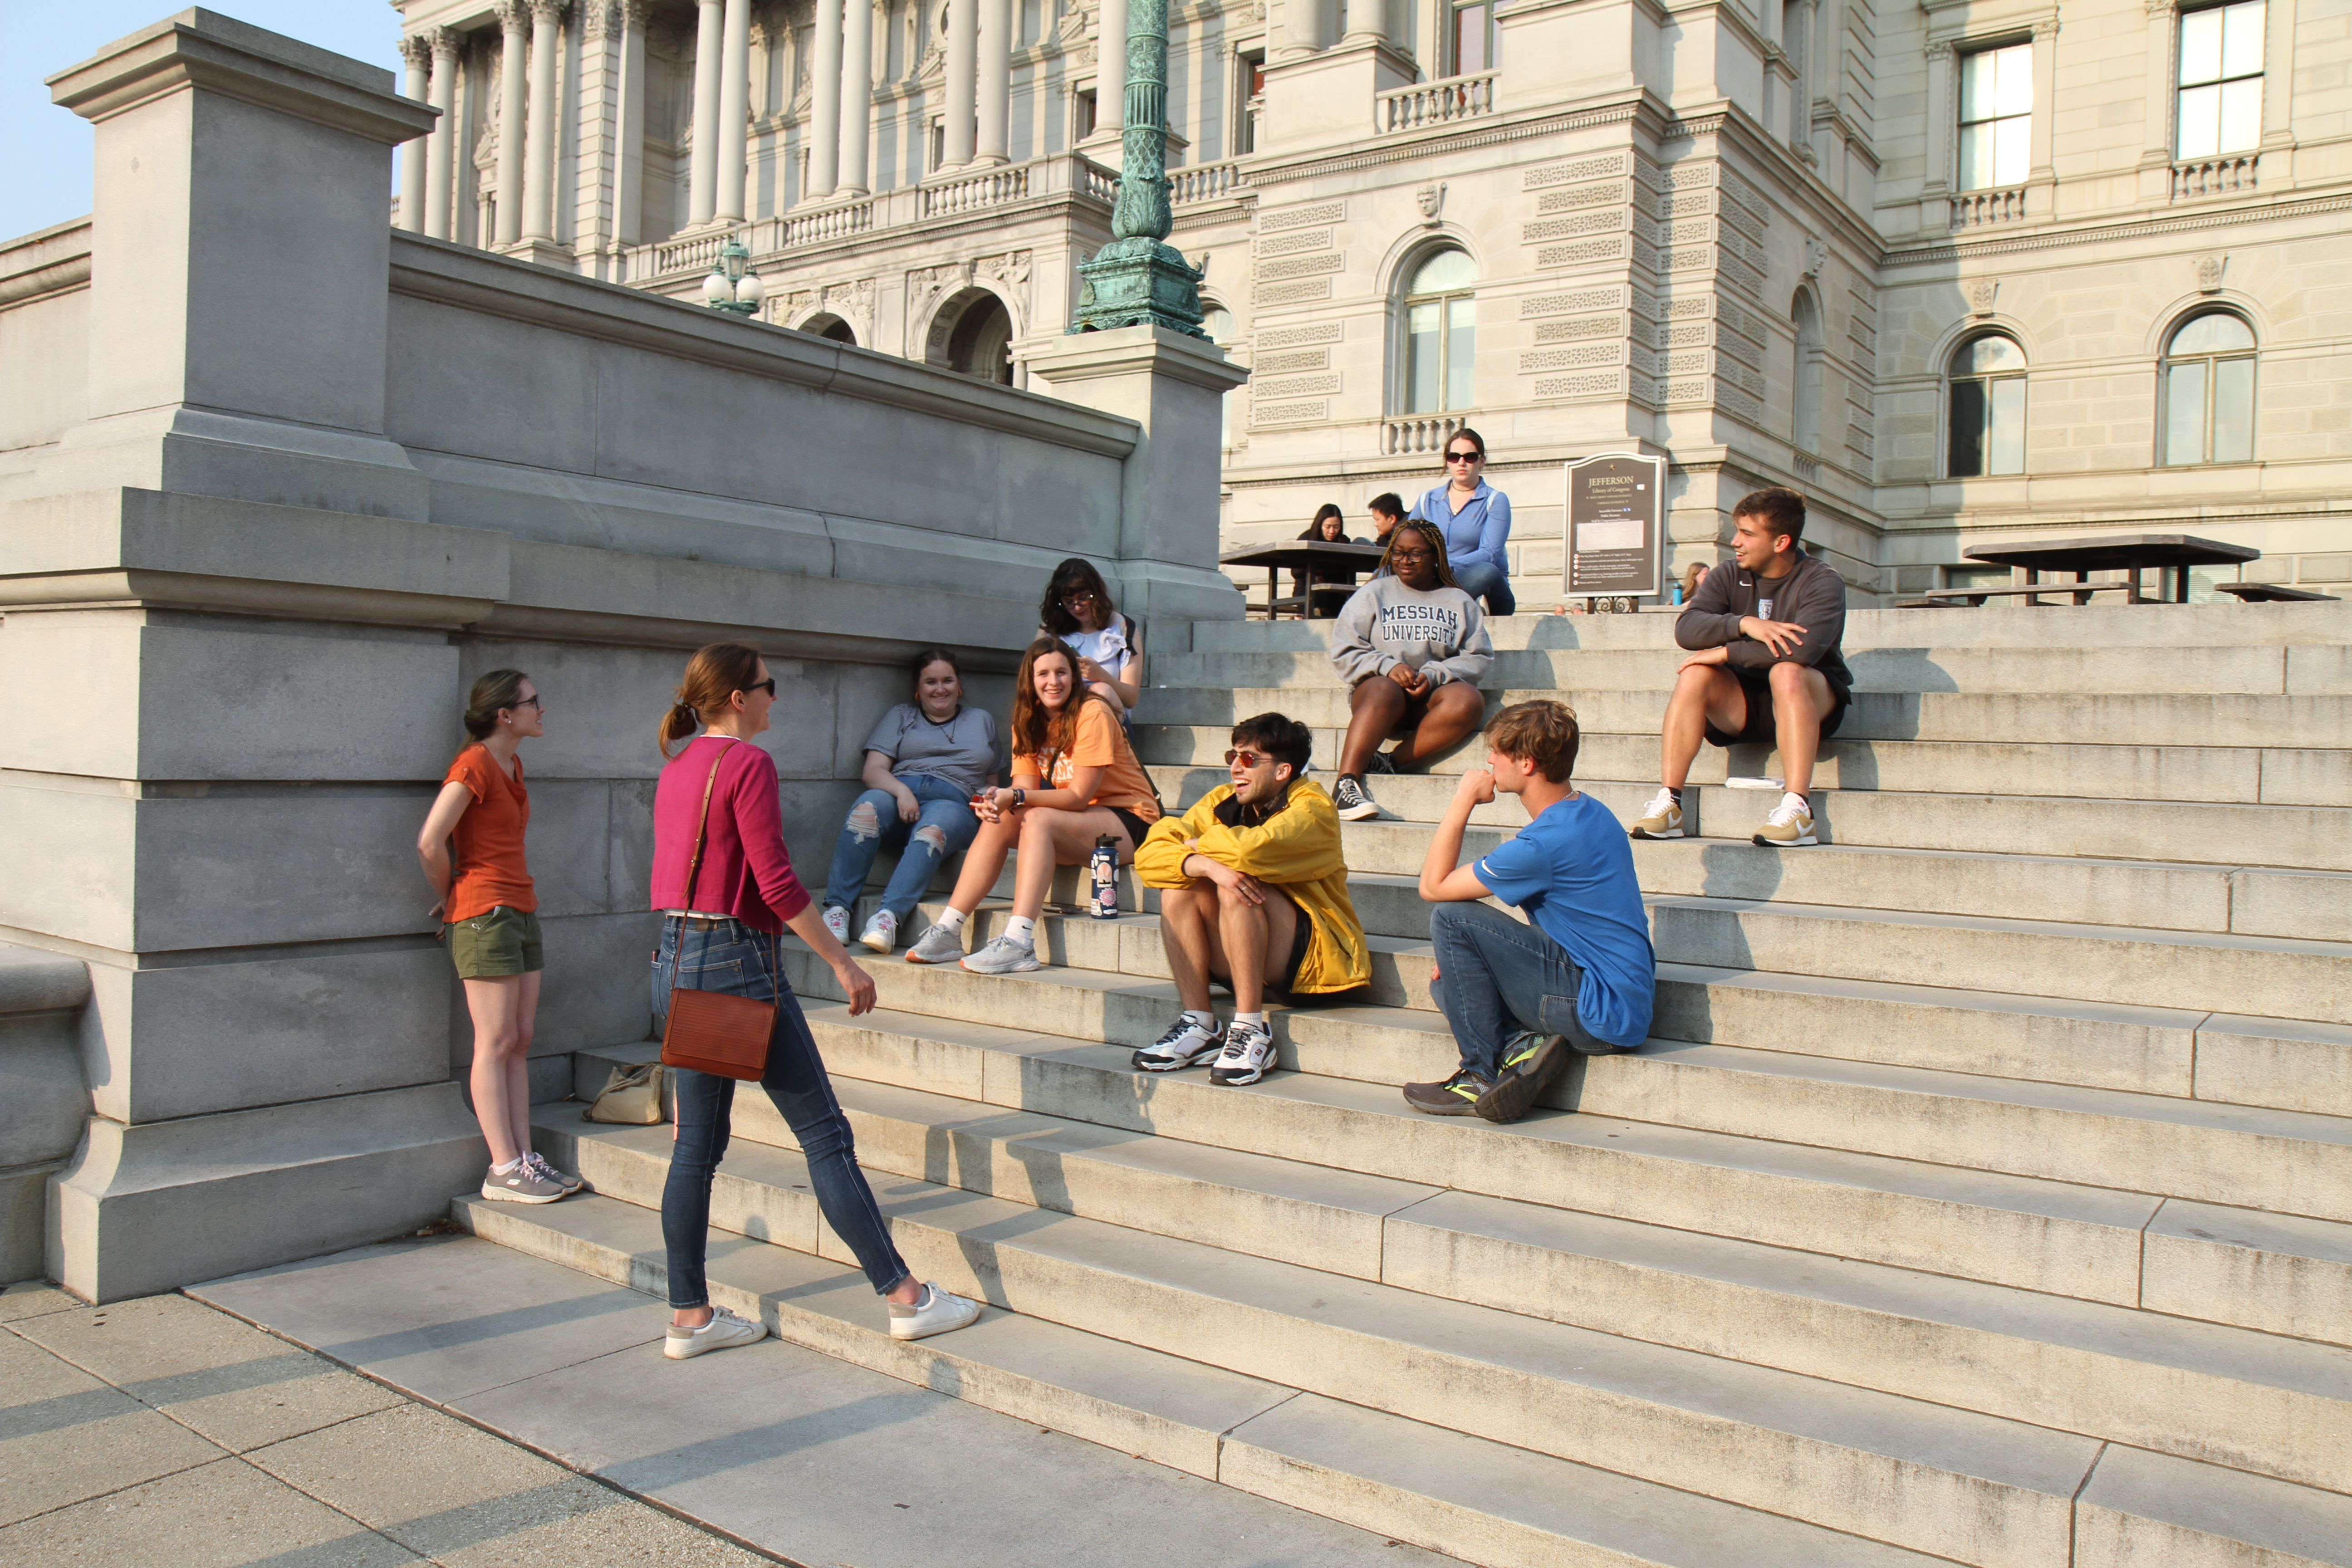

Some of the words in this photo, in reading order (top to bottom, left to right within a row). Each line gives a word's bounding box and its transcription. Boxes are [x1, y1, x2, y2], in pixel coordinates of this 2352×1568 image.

[1588, 476, 1634, 488] JEFFERSON
[1382, 604, 1458, 629] MESSIAH
[1382, 624, 1455, 647] UNIVERSITY
